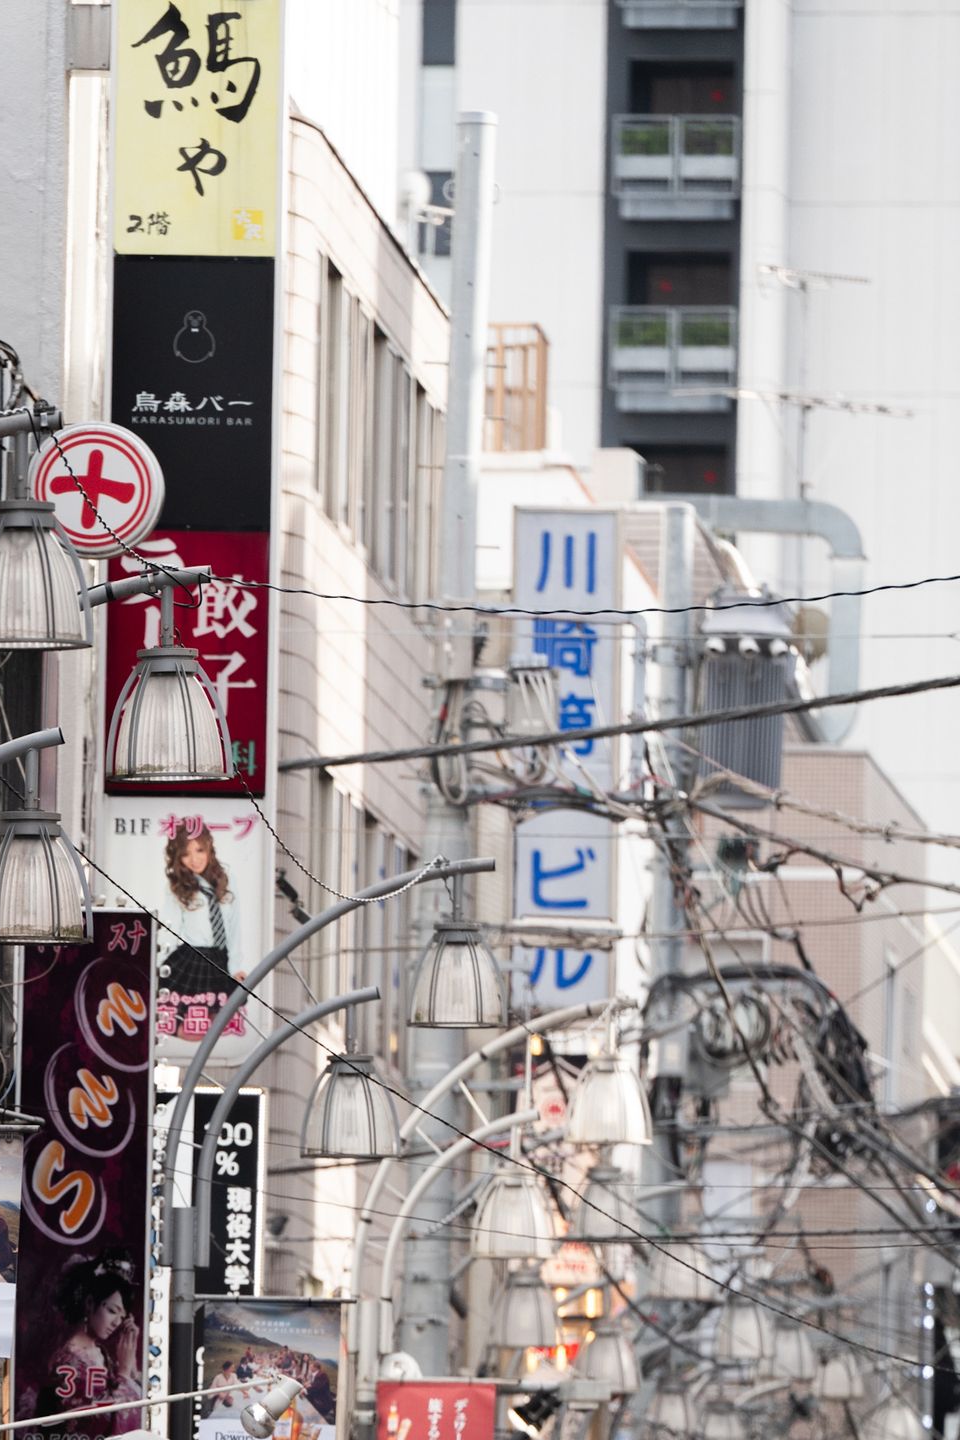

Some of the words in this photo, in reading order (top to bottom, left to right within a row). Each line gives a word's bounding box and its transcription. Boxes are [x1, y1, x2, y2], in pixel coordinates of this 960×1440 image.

[126, 212, 172, 237] 2階
[131, 416, 221, 425] KARASUMORI
[226, 417, 253, 426] BAR
[114, 816, 151, 836] B1F
[158, 813, 260, 841] オリーブ
[55, 1366, 108, 1398] 3F
